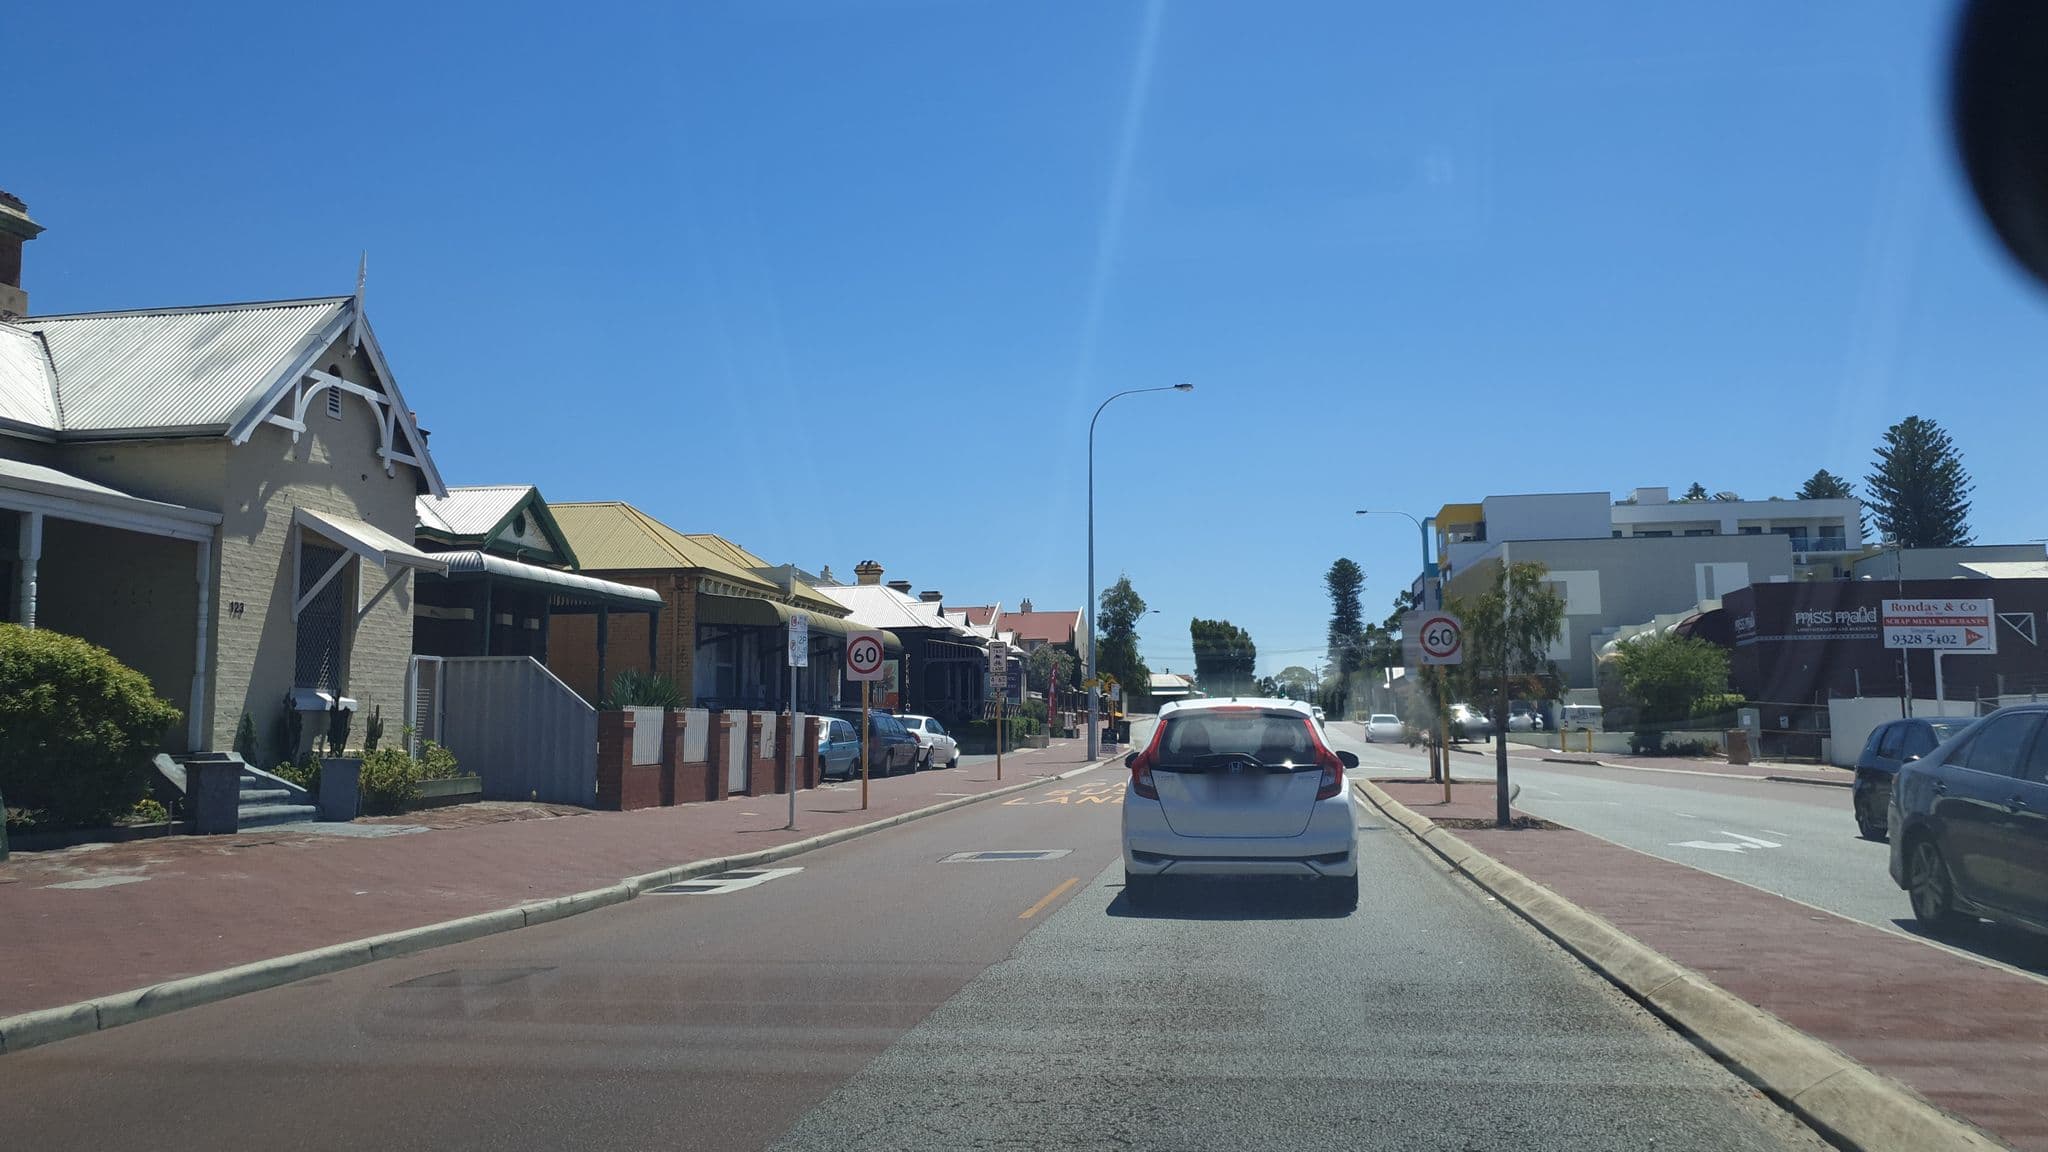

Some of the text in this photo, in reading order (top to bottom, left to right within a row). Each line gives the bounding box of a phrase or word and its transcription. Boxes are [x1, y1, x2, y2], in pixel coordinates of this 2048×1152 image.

[1890, 602, 1977, 612] Rondas & Co
[1795, 608, 1832, 626] miss
[1428, 628, 1454, 646] 60
[1892, 634, 1922, 645] 9328
[1926, 634, 1957, 645] 5402
[854, 646, 877, 663] 60
